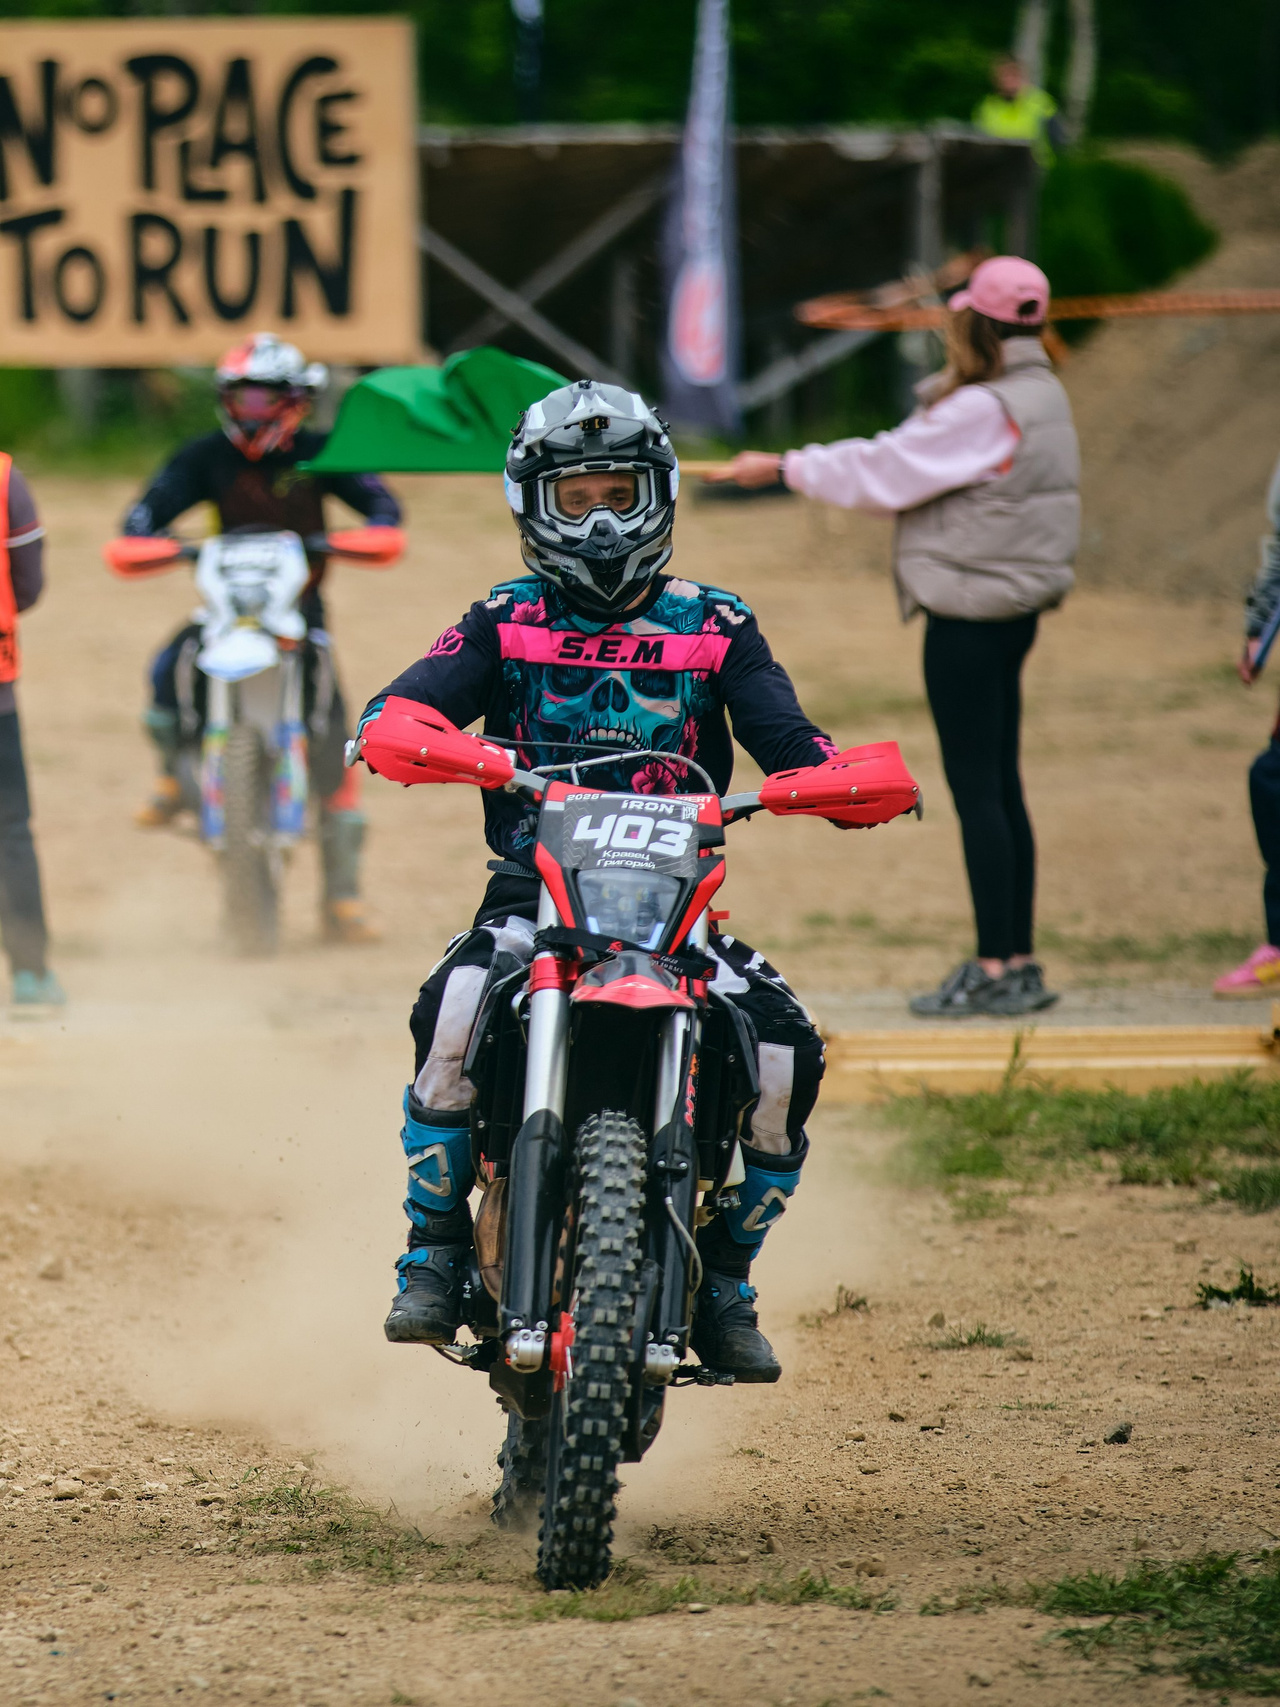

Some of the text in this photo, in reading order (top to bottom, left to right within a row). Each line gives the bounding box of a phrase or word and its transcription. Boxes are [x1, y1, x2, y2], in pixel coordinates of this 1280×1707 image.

[125, 54, 361, 202] PLACE
[131, 189, 357, 325] RUN
[558, 636, 665, 664] S.E.M
[572, 814, 694, 857] 403
[596, 858, 656, 870] Григорий
[602, 849, 650, 862] Кравец
